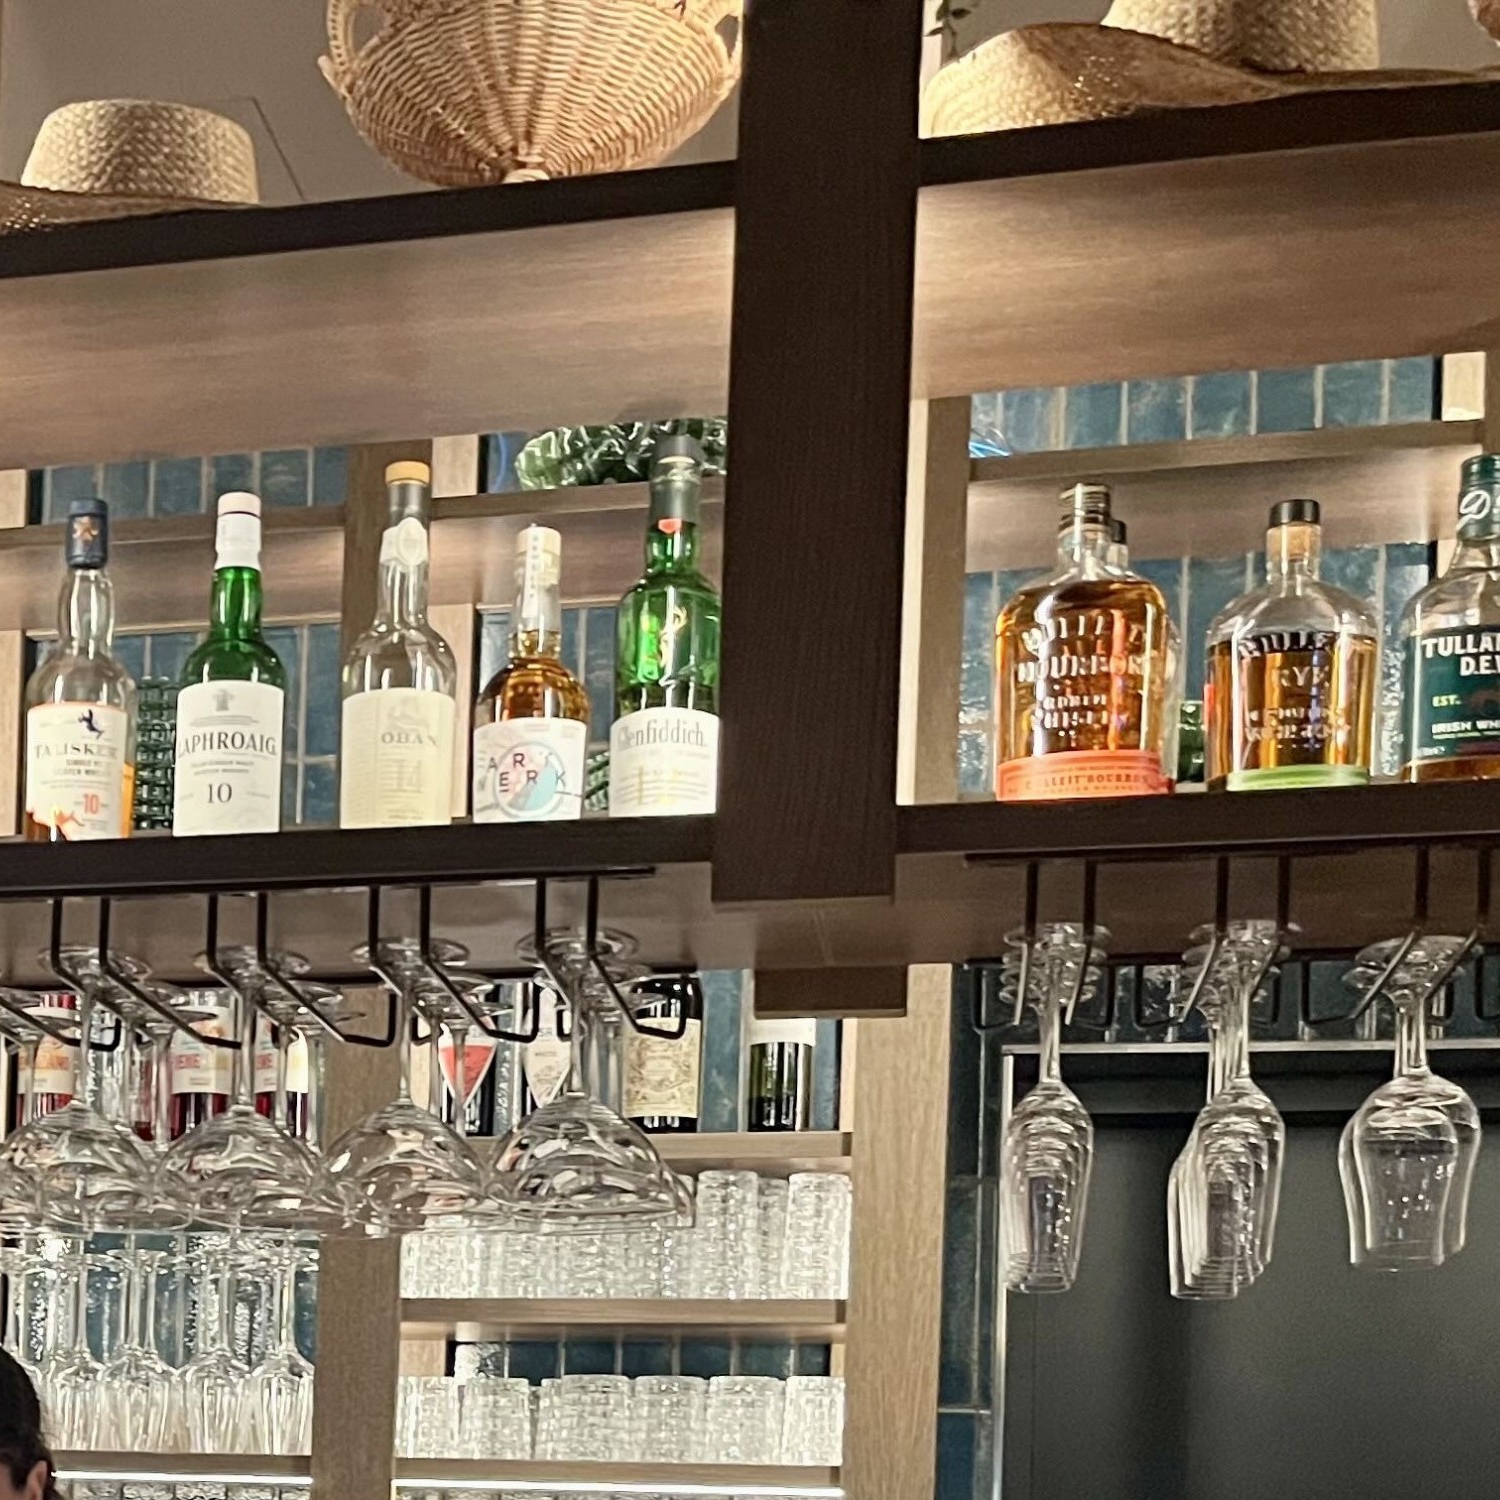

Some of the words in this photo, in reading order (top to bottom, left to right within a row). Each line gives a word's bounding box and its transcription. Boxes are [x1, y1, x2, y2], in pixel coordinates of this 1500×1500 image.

[1421, 633, 1500, 658] TULLA
[83, 793, 100, 814] 10
[207, 782, 233, 804] 10
